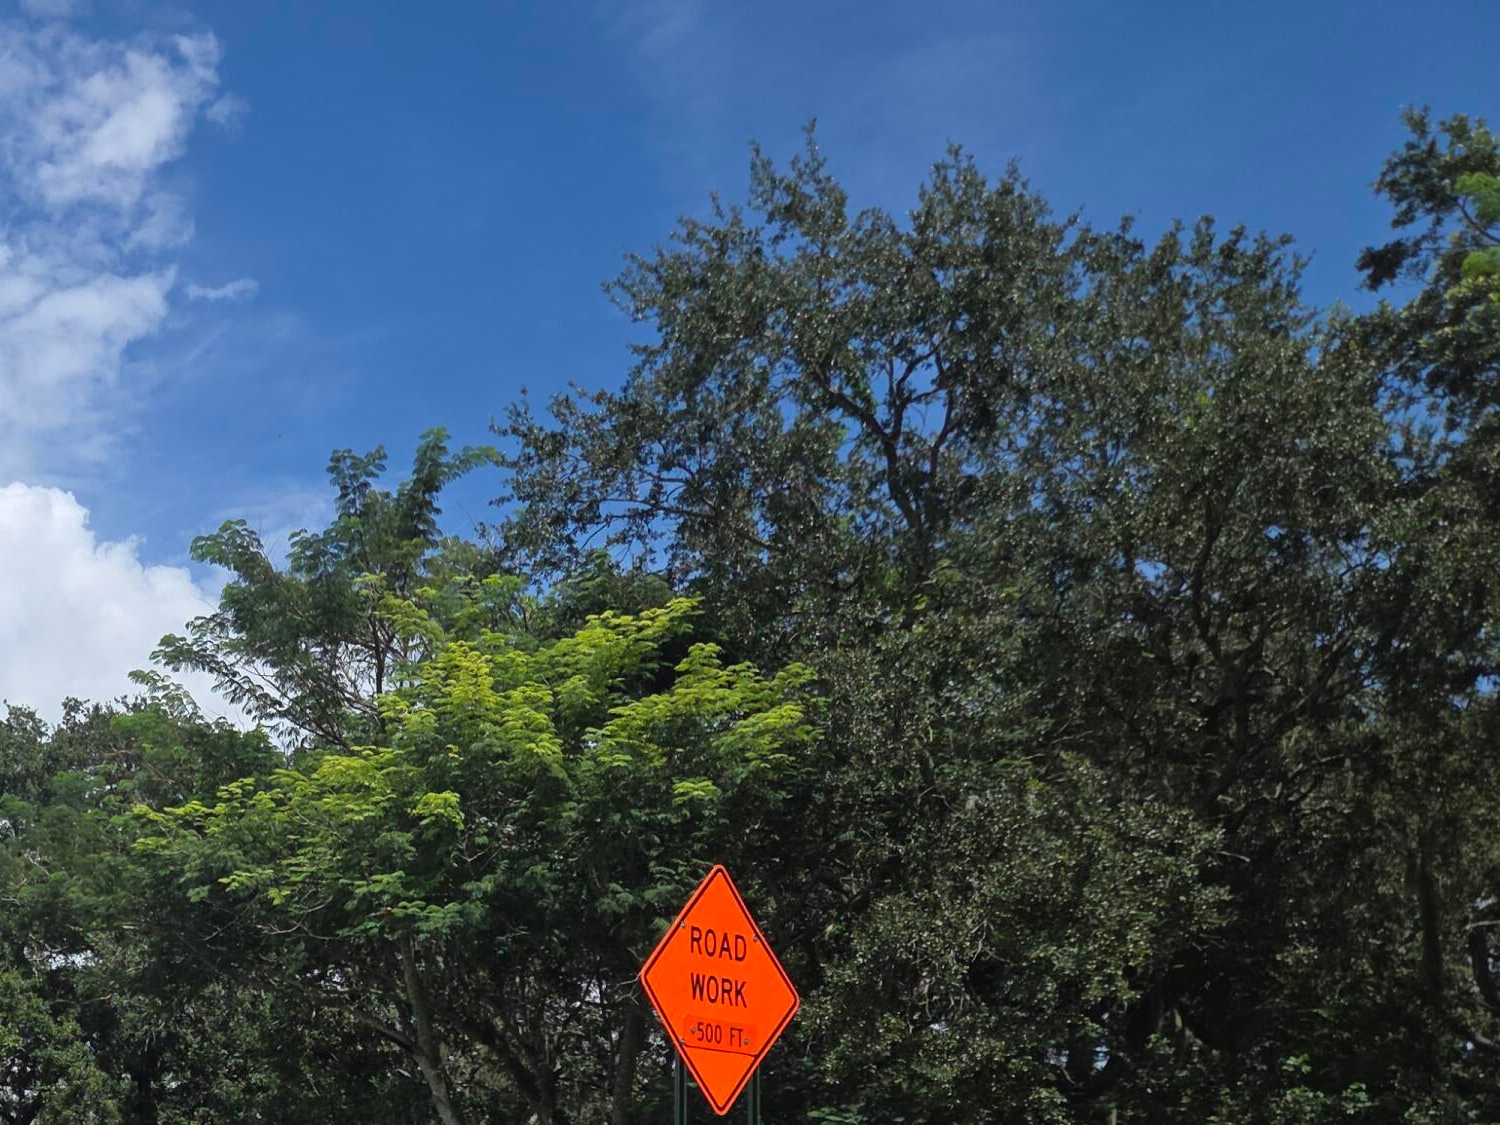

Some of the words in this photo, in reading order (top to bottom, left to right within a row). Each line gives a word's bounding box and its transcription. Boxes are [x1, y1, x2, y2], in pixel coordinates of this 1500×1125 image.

[690, 926, 747, 961] ROAD
[690, 972, 747, 1008] WORK
[697, 1022, 722, 1045] 500
[729, 1027, 743, 1048] FT
